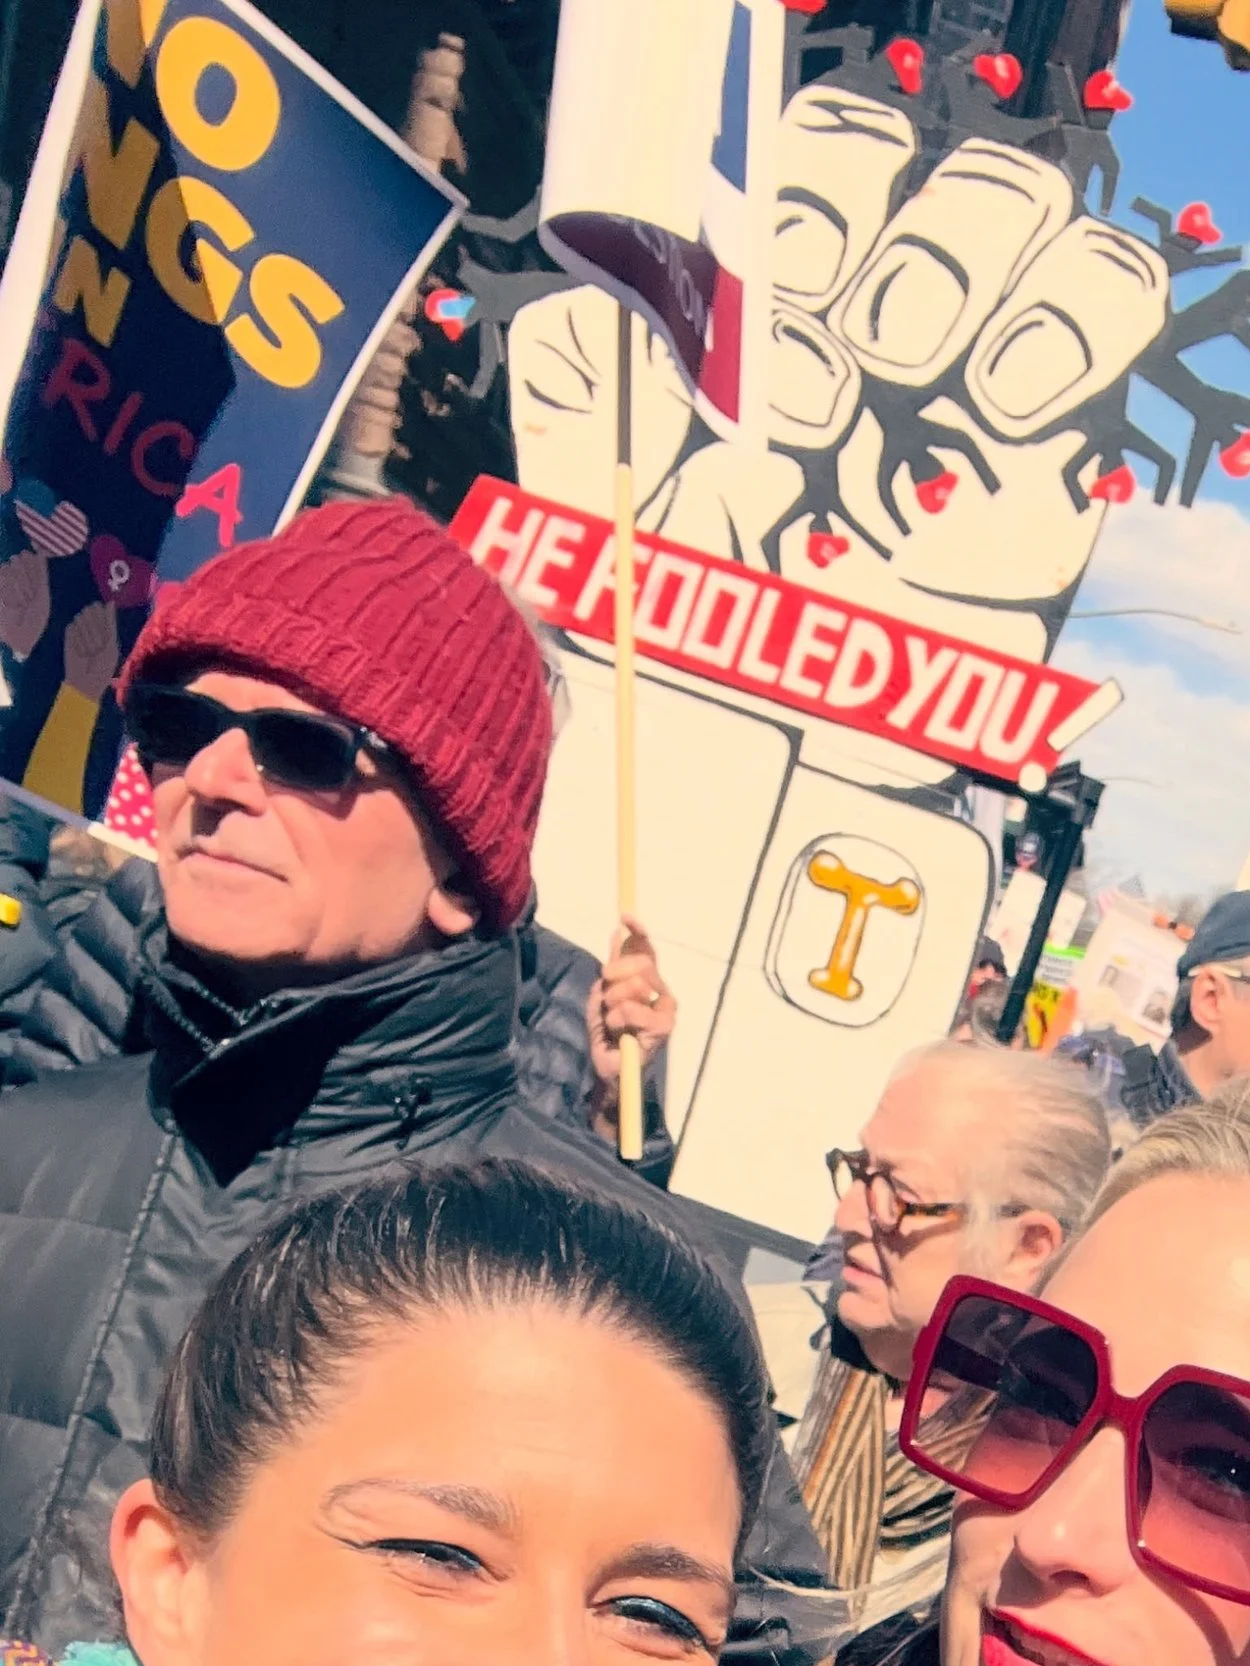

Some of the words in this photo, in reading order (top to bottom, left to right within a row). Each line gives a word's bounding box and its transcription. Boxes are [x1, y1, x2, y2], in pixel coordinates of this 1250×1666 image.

[469, 496, 587, 608] HE
[573, 532, 894, 709] FOOLED
[888, 636, 1125, 793] YOU!
[806, 849, 921, 1001] T
